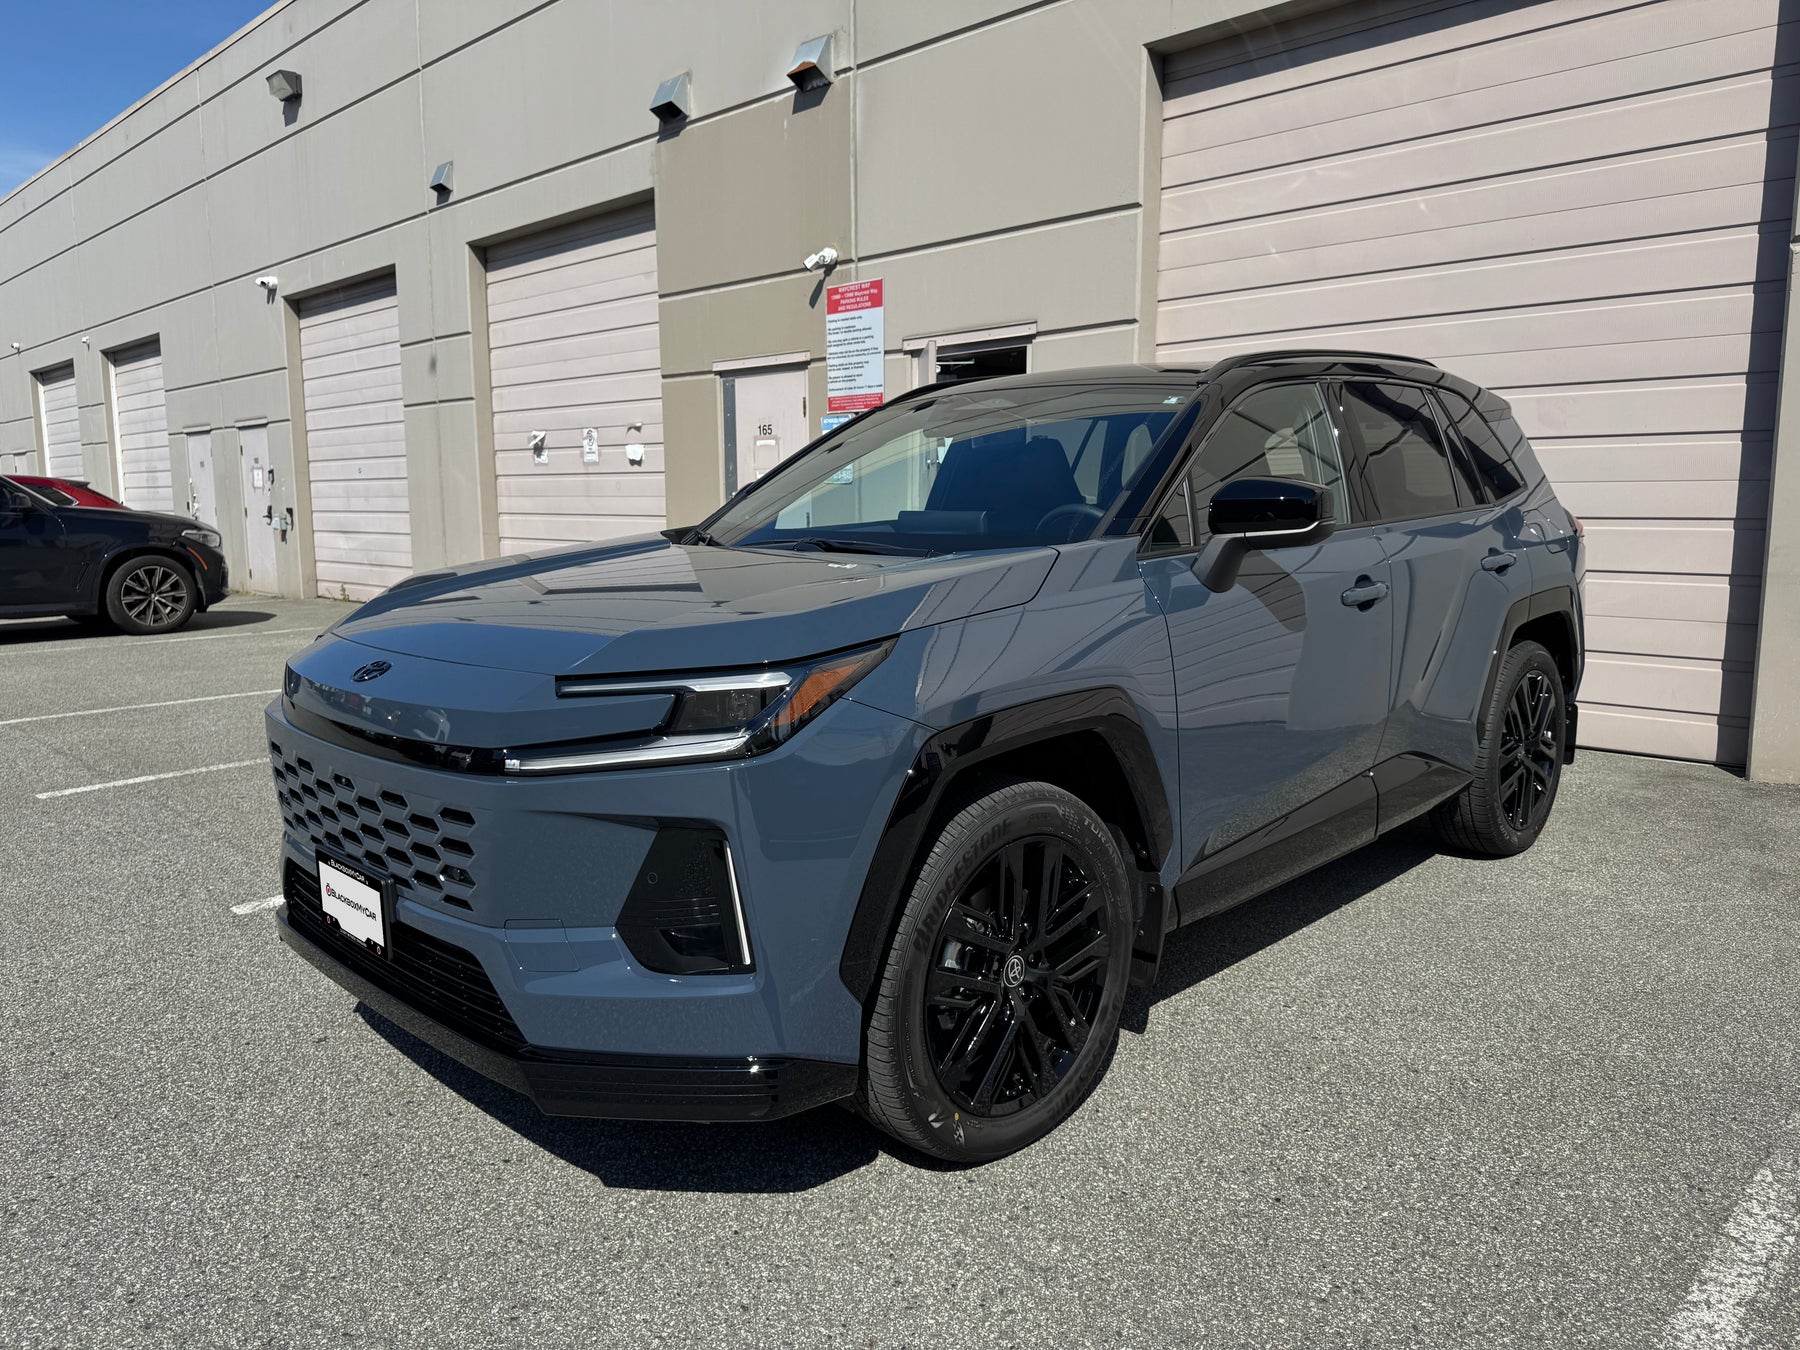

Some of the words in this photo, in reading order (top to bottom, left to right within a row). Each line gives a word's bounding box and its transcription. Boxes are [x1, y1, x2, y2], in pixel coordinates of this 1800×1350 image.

[758, 424, 773, 435] 165
[912, 817, 1011, 953] BRIDGESTONE
[331, 888, 377, 921] BLACKBOXMYCAR
